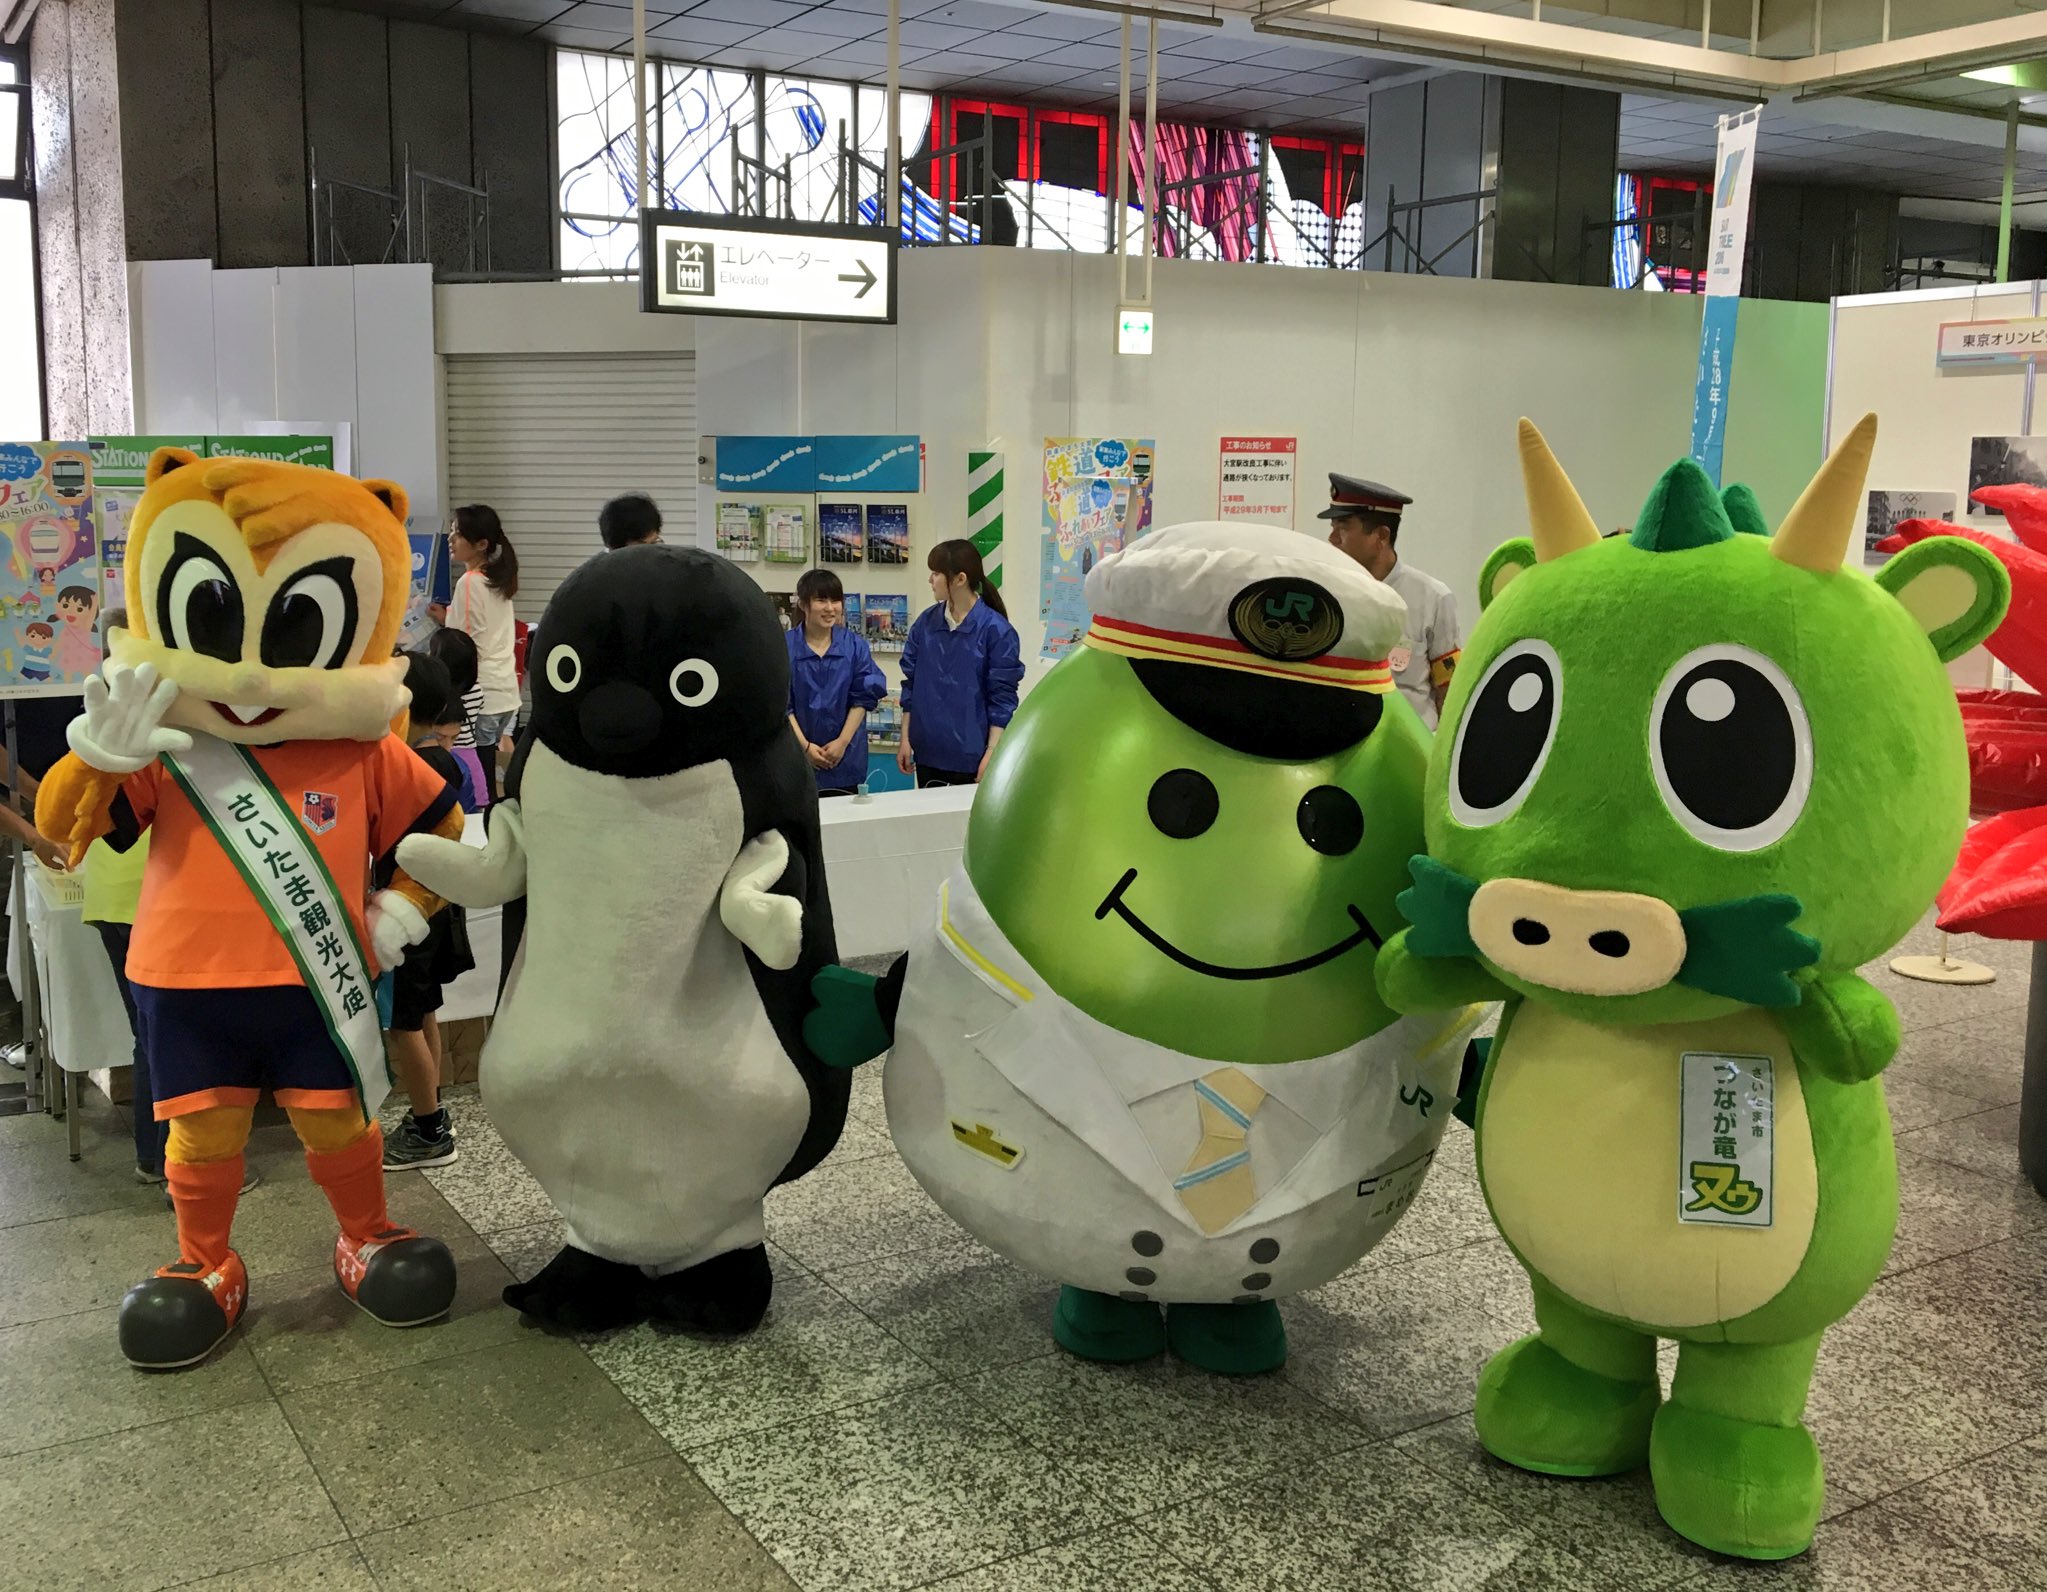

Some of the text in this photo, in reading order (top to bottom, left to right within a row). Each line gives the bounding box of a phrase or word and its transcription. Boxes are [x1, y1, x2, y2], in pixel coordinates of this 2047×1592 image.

[719, 270, 769, 286] Elevator
[1962, 329, 2047, 348] 東京オリンピ
[227, 791, 369, 1020] さいたま観光大使
